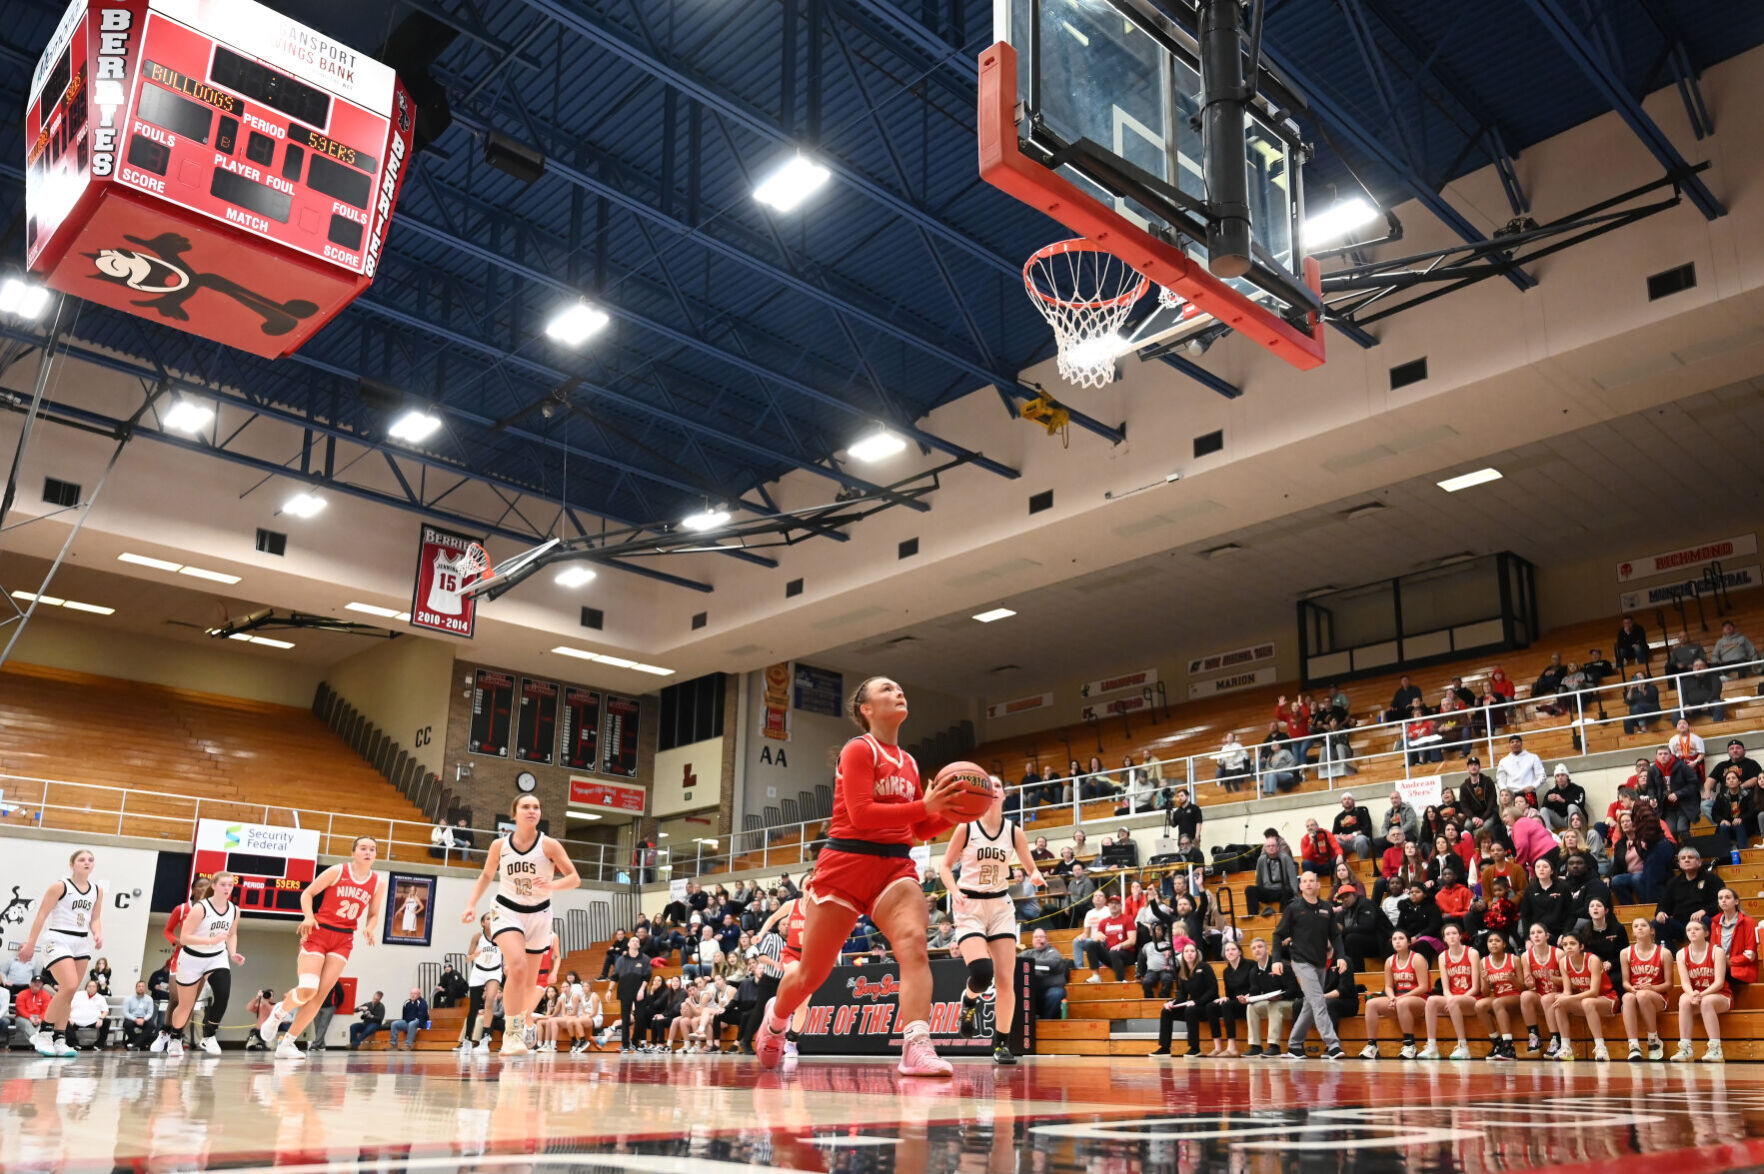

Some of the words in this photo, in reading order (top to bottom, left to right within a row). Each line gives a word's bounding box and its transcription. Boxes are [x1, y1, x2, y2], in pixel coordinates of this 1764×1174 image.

[319, 57, 356, 84] BANK
[151, 63, 235, 112] BULLDOGS
[133, 121, 176, 147] FOULS
[243, 112, 286, 140] PERIOD
[307, 131, 356, 165] 59ERS
[122, 168, 165, 193] SCORE
[214, 154, 260, 182] PLAYER
[265, 175, 296, 196] FOUL
[332, 202, 368, 225] FOULS
[365, 130, 405, 278] BERRIES
[226, 207, 269, 232] MATCH
[323, 245, 359, 267] SCORE
[424, 527, 470, 551] BERRIE
[439, 572, 457, 592] 15
[417, 611, 441, 626] 2010
[446, 617, 468, 631] 2014
[1216, 673, 1256, 690] MARION
[415, 726, 432, 748] CC
[247, 839, 287, 852] Federal
[248, 828, 294, 844] Security
[976, 846, 1007, 863] DOGS
[507, 861, 537, 876] DOGS
[978, 865, 999, 886] 21
[243, 881, 265, 889] PERIOD
[275, 878, 301, 890] 59ERS
[513, 877, 533, 897] 12
[71, 899, 93, 912] DOGS
[114, 892, 131, 909] C
[336, 885, 372, 905] NINERS
[335, 899, 360, 920] 20
[210, 920, 230, 931] DOGS
[833, 1004, 860, 1036] OF
[858, 1003, 896, 1036] THE
